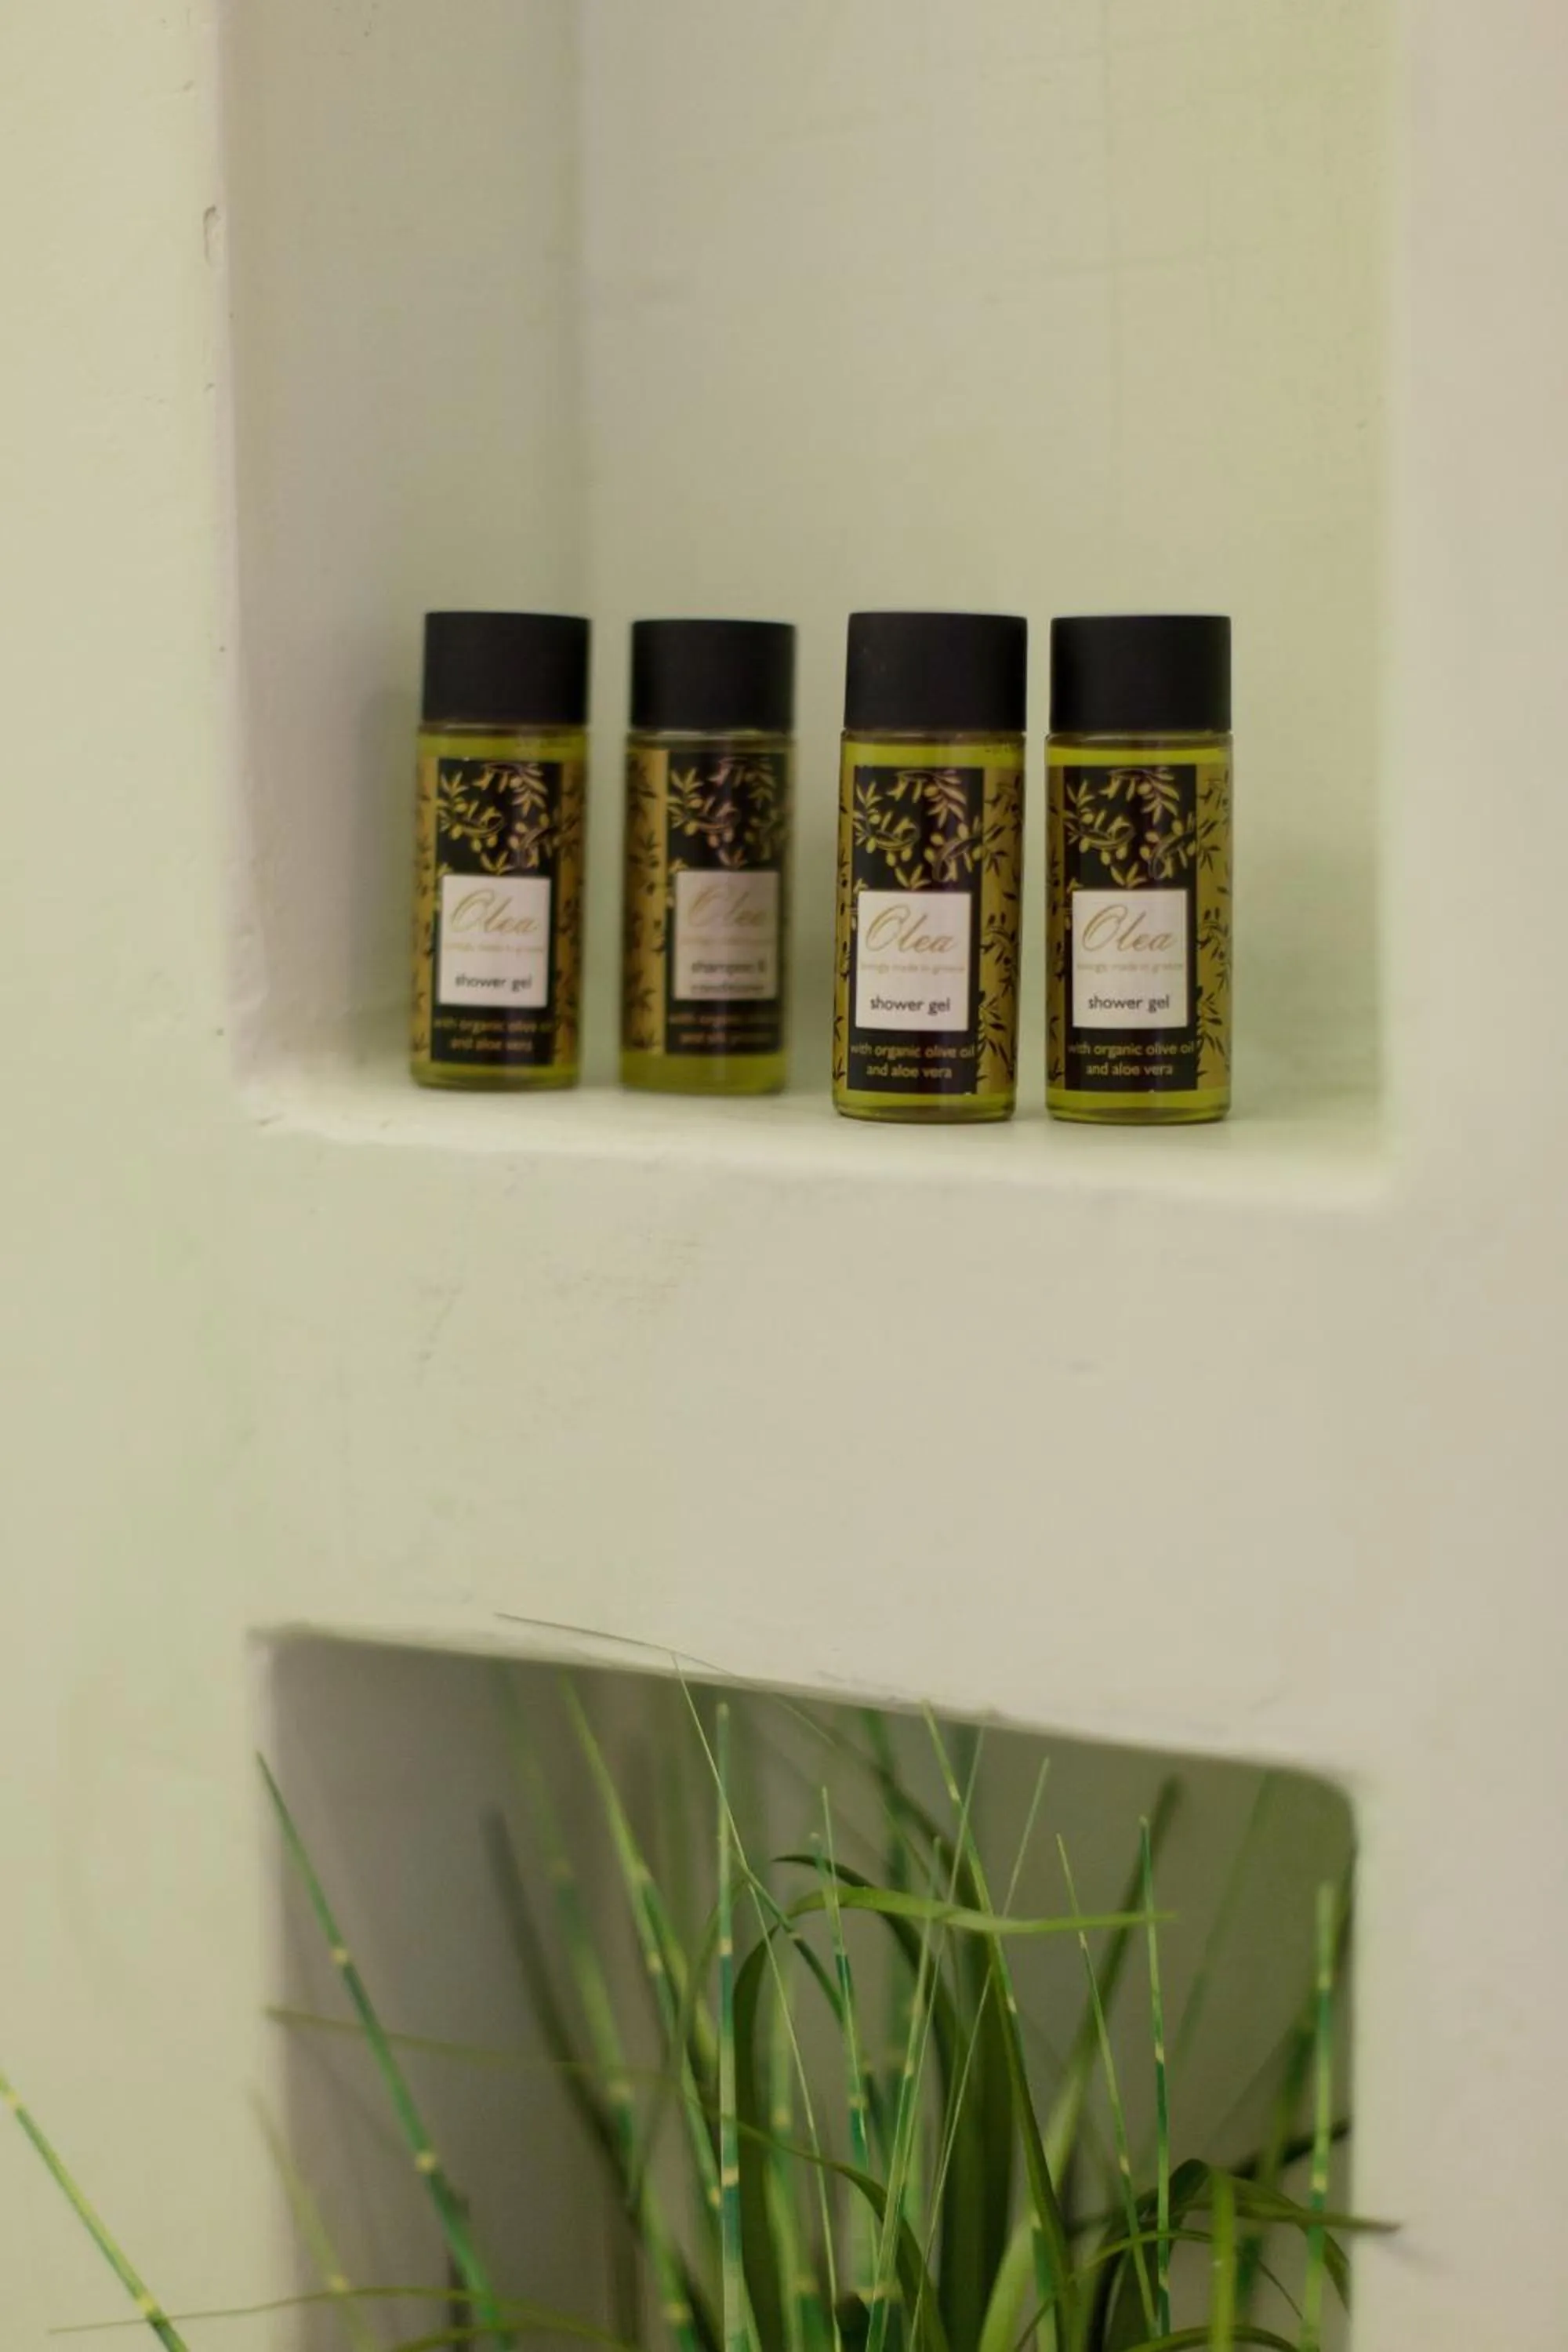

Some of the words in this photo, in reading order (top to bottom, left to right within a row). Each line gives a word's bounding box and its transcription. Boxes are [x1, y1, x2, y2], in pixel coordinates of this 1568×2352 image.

[450, 887, 539, 935] Olea
[865, 902, 956, 954] Olea
[1081, 903, 1174, 953] Olea
[455, 972, 506, 989] shower
[511, 973, 532, 993] gel
[870, 996, 925, 1012] shower
[928, 997, 951, 1016] gel
[1088, 995, 1143, 1011] shower
[1147, 996, 1171, 1014] gel
[850, 1042, 873, 1055] with
[874, 1044, 921, 1061] organic
[925, 1045, 957, 1058] olive
[959, 1044, 975, 1058] oil
[1067, 1041, 1091, 1054] with
[1093, 1043, 1142, 1059] organic
[1145, 1042, 1178, 1056] olive
[1179, 1040, 1195, 1054] oil
[866, 1062, 888, 1077] and
[891, 1064, 920, 1079] aloe
[923, 1067, 953, 1080] vera
[1086, 1061, 1109, 1076] and
[1112, 1061, 1141, 1076] aloe
[1144, 1065, 1174, 1077] vera
